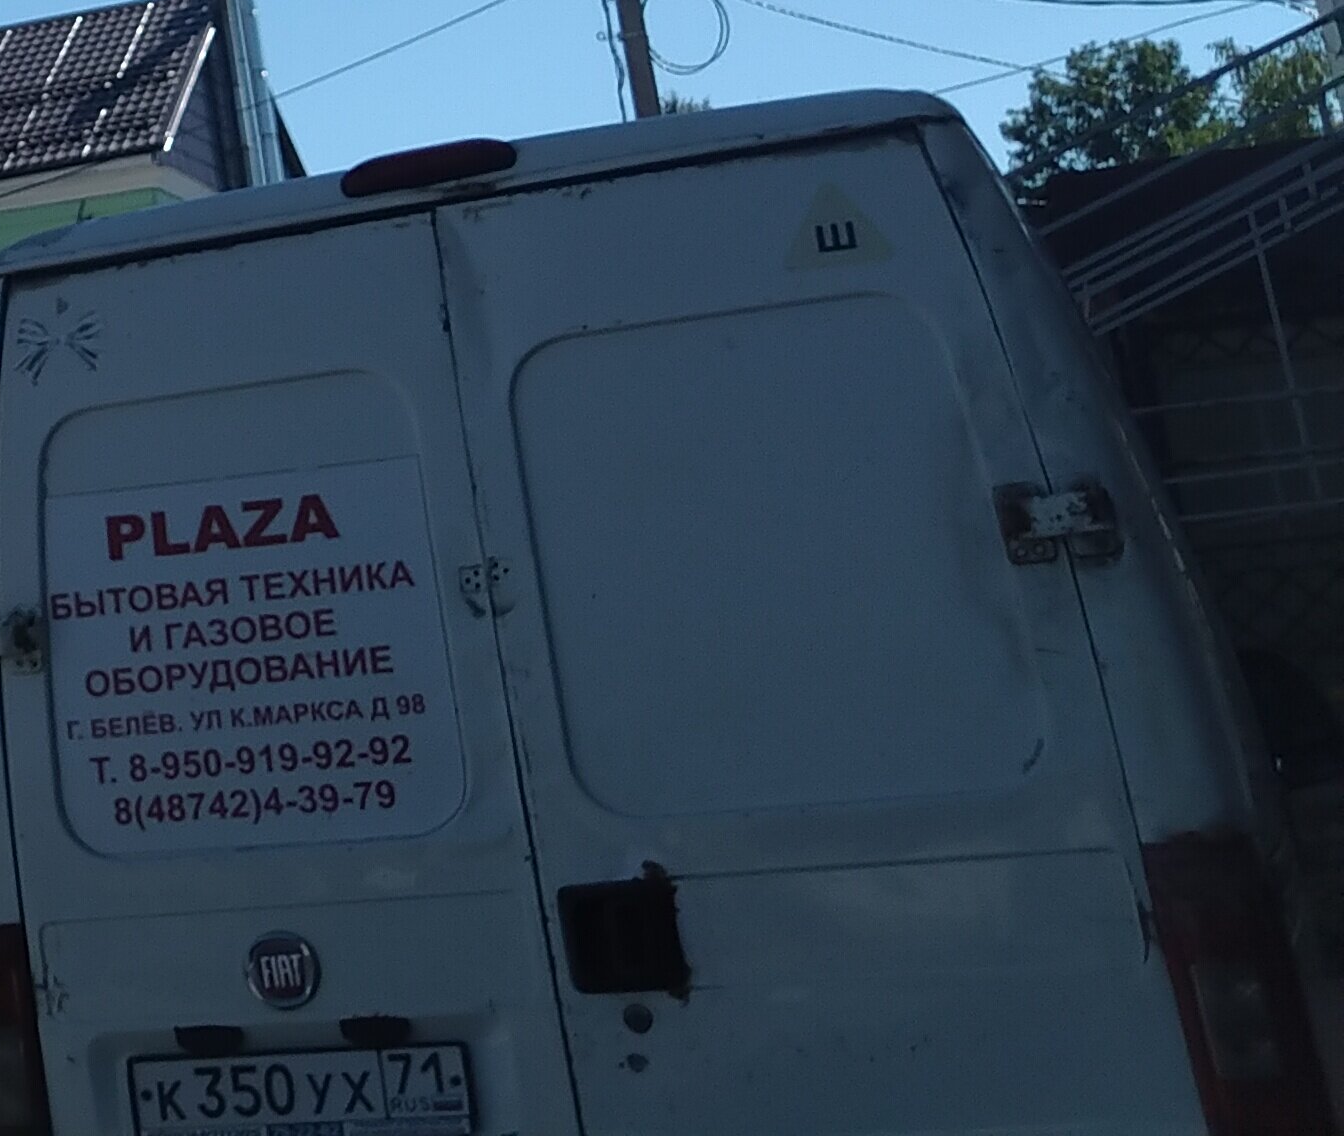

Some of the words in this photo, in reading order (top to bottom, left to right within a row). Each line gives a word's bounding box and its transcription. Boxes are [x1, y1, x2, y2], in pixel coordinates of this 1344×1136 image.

[815, 221, 857, 253] Ш
[105, 493, 341, 561] PLAZA
[51, 578, 230, 619] БЫТОВАЯ
[239, 560, 415, 602] ТЕХНИКА
[130, 625, 151, 653] И
[166, 608, 337, 650] ГАЗОВОЕ
[85, 645, 394, 697] ОБОРУДОВАНИЕ
[67, 720, 83, 741] Г.
[230, 700, 363, 728] К.МАРКСА
[371, 697, 390, 720] Д
[396, 693, 425, 714] 98
[89, 756, 117, 784] Т.
[129, 734, 412, 783] 8-950-919-92-92
[114, 779, 396, 831] 8(48742)4-39-79
[259, 953, 302, 989] FIAT
[387, 1051, 445, 1095] 71
[390, 1095, 430, 1113] RUS
